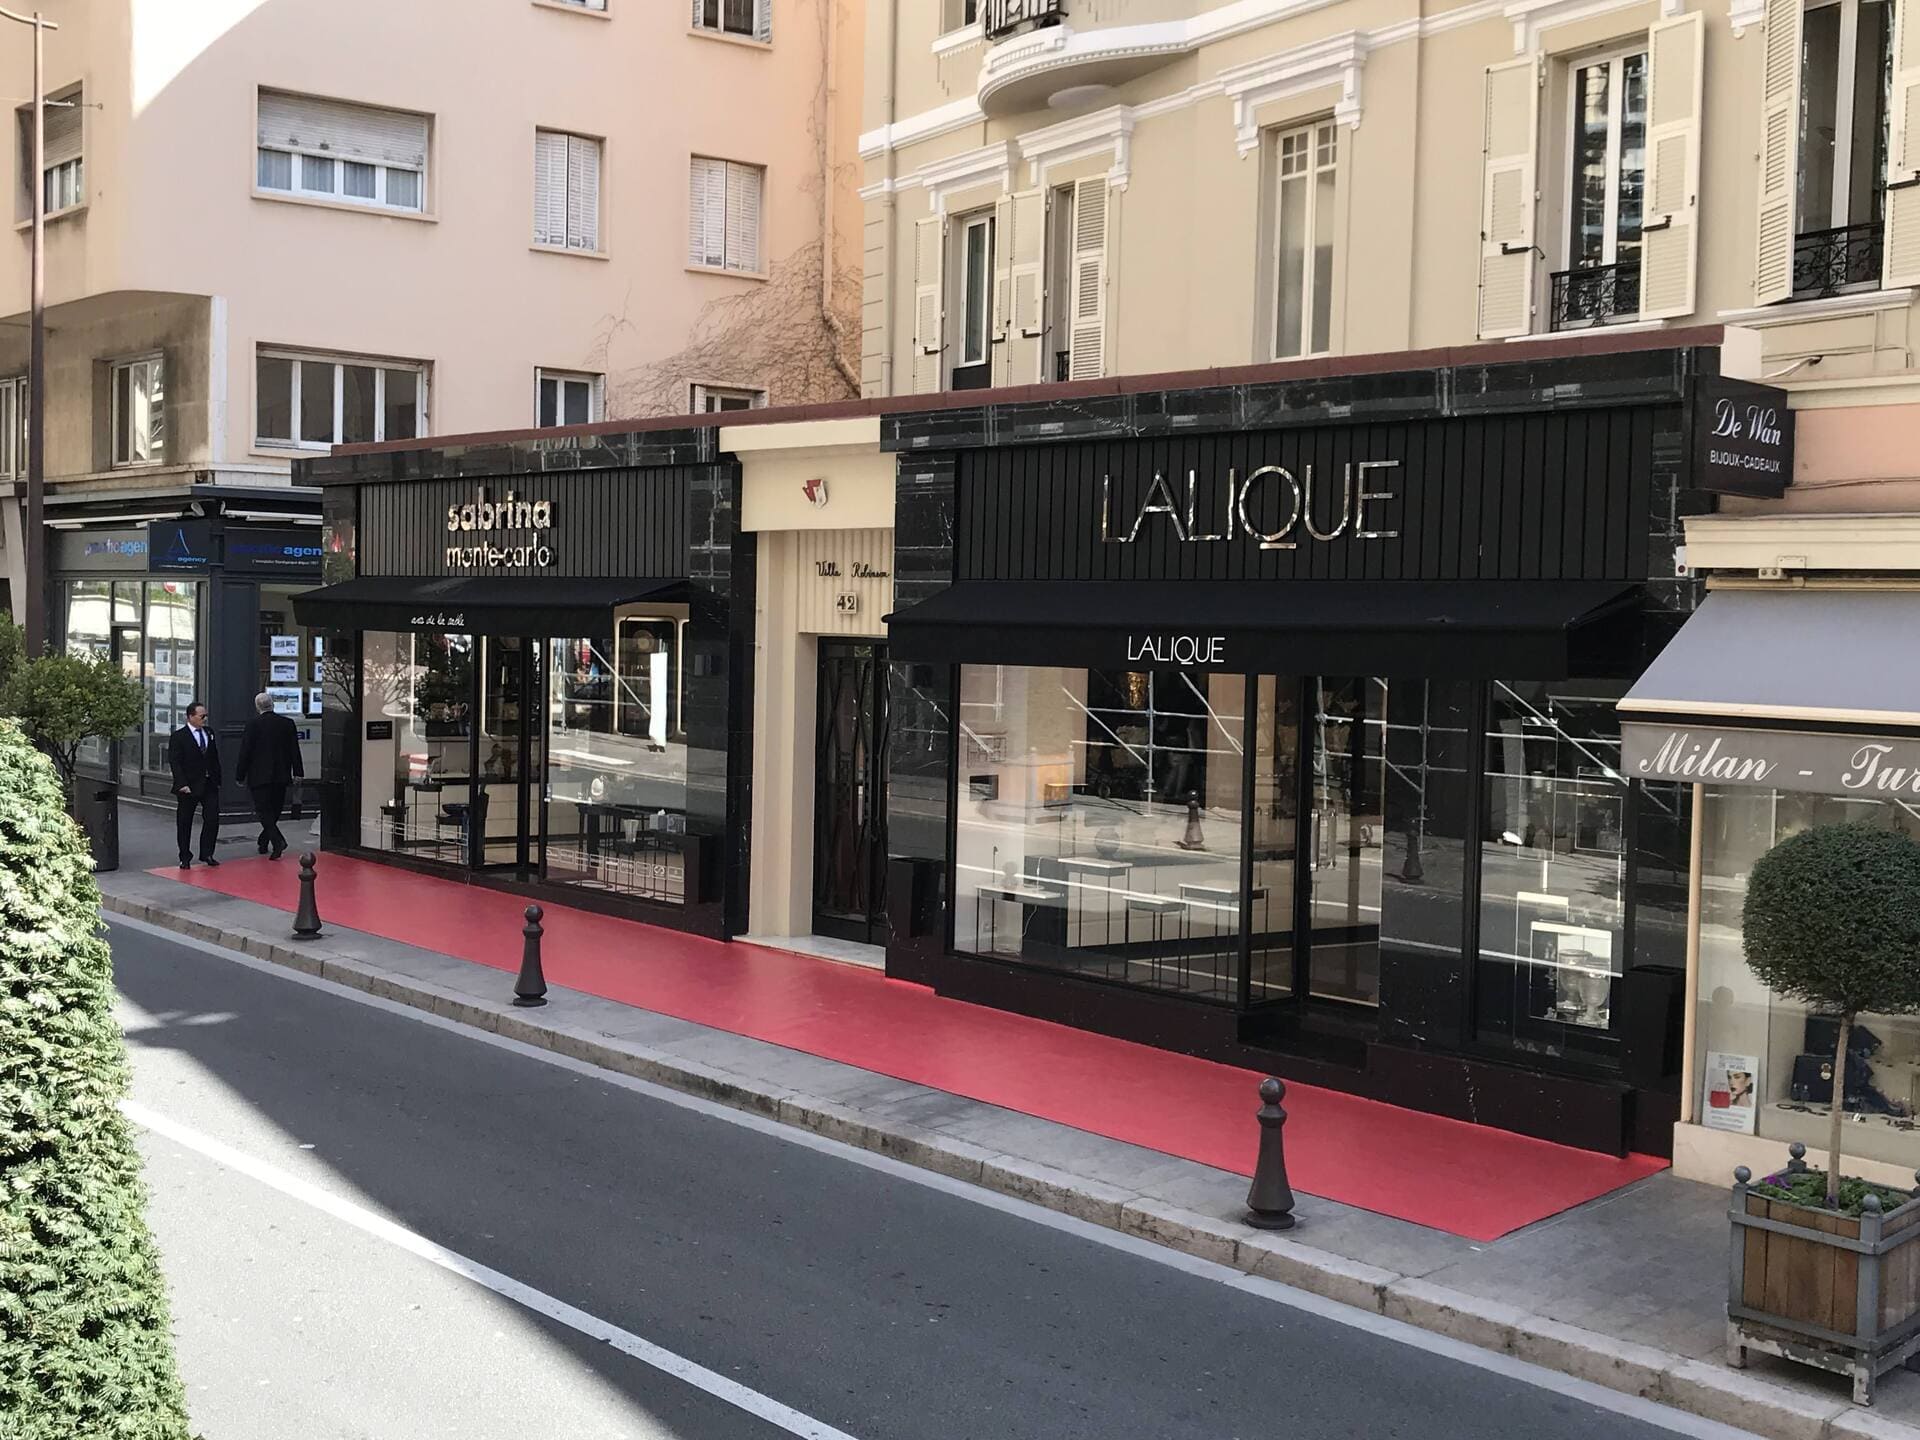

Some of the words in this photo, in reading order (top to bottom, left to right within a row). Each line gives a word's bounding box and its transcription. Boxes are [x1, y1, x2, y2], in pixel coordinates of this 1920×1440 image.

[1711, 398, 1742, 438] De
[1746, 405, 1781, 445] Wan
[1710, 449, 1780, 473] BIJOUX-CADEAUX
[447, 486, 551, 532] sabrina
[1102, 460, 1399, 549] LALIQUE
[446, 532, 551, 567] monte-carlo
[815, 560, 841, 577] Villa
[836, 595, 855, 610] 42
[1127, 635, 1225, 665] LALIQUE
[1639, 732, 1778, 782] Milan
